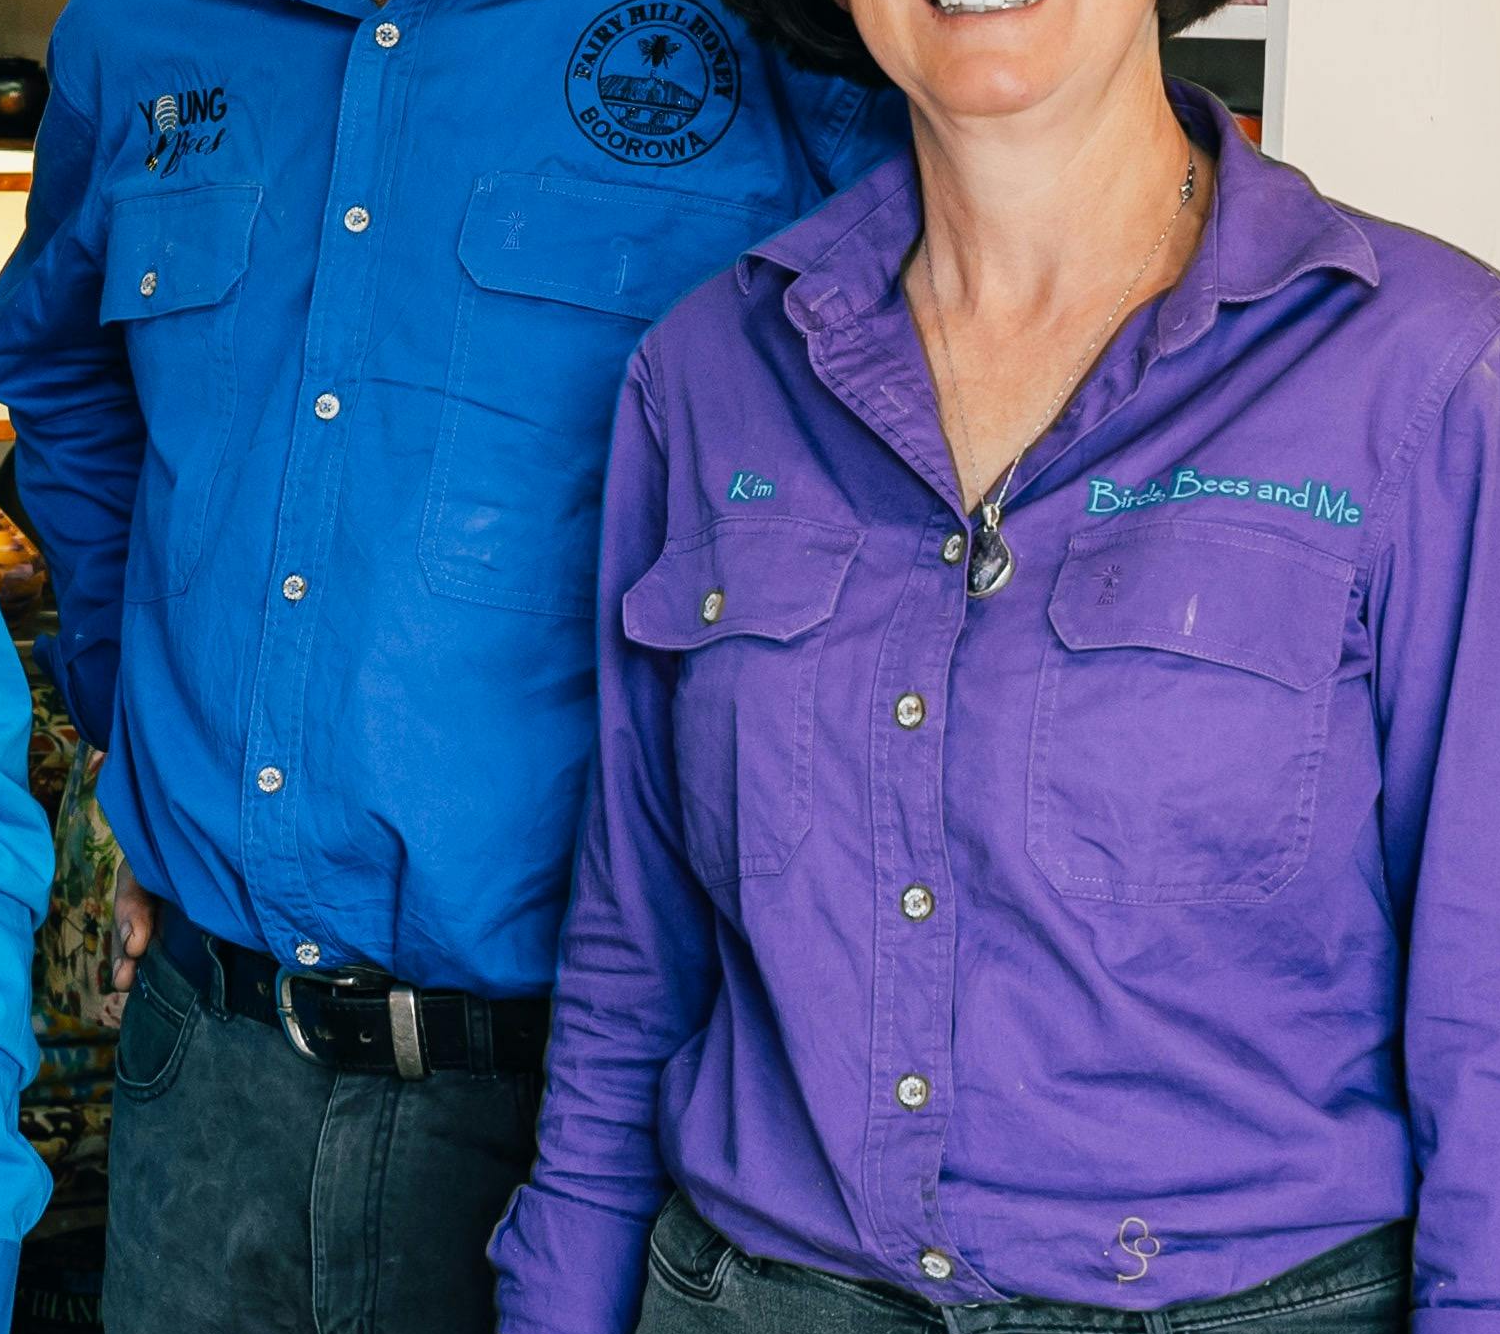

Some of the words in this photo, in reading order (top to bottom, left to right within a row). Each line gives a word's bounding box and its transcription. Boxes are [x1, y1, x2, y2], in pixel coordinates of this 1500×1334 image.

[573, 13, 626, 81] FAIRY
[626, 2, 689, 26] HILL
[687, 13, 734, 100] HONEY
[161, 125, 232, 179] Bees
[579, 106, 708, 160] BOOROWA
[730, 472, 774, 500] Kim
[1171, 469, 1250, 500] Bees
[1256, 483, 1311, 509] and
[1314, 489, 1361, 524] Me
